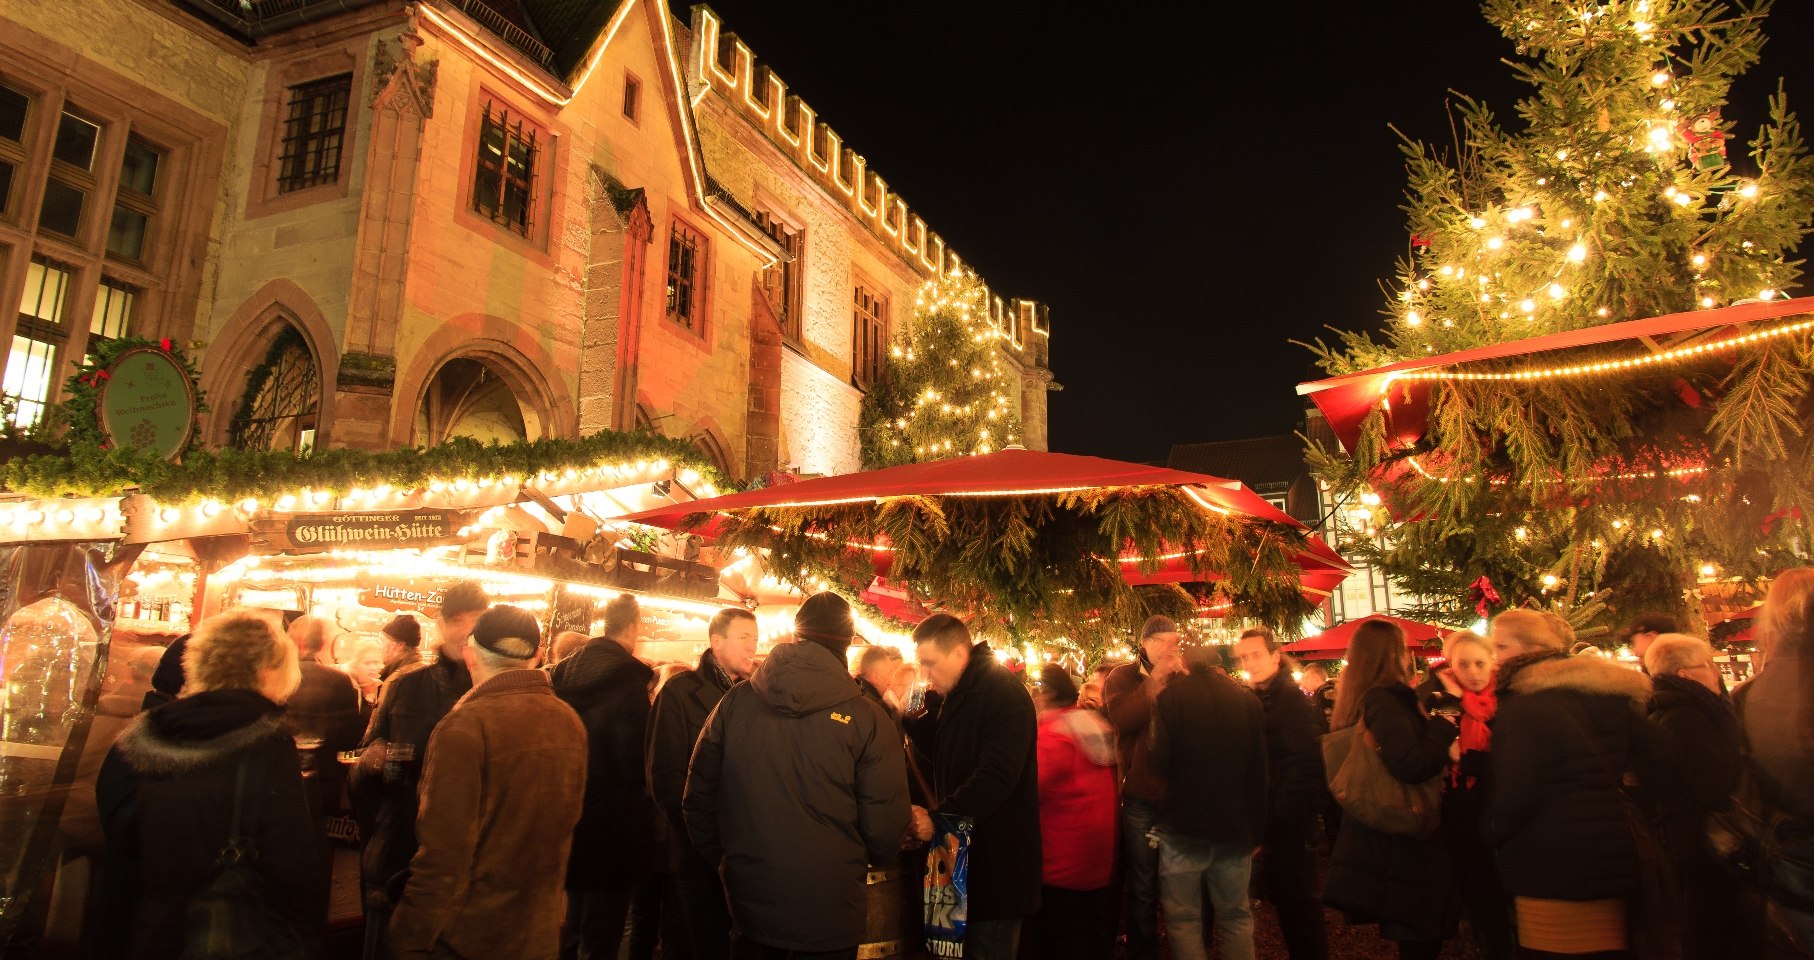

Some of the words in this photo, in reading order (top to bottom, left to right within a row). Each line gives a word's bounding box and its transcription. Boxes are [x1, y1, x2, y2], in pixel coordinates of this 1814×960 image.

[115, 400, 176, 416] Weihnachten
[333, 514, 400, 523] GÖTTINGER
[295, 523, 445, 545] Glühwein-Hütte
